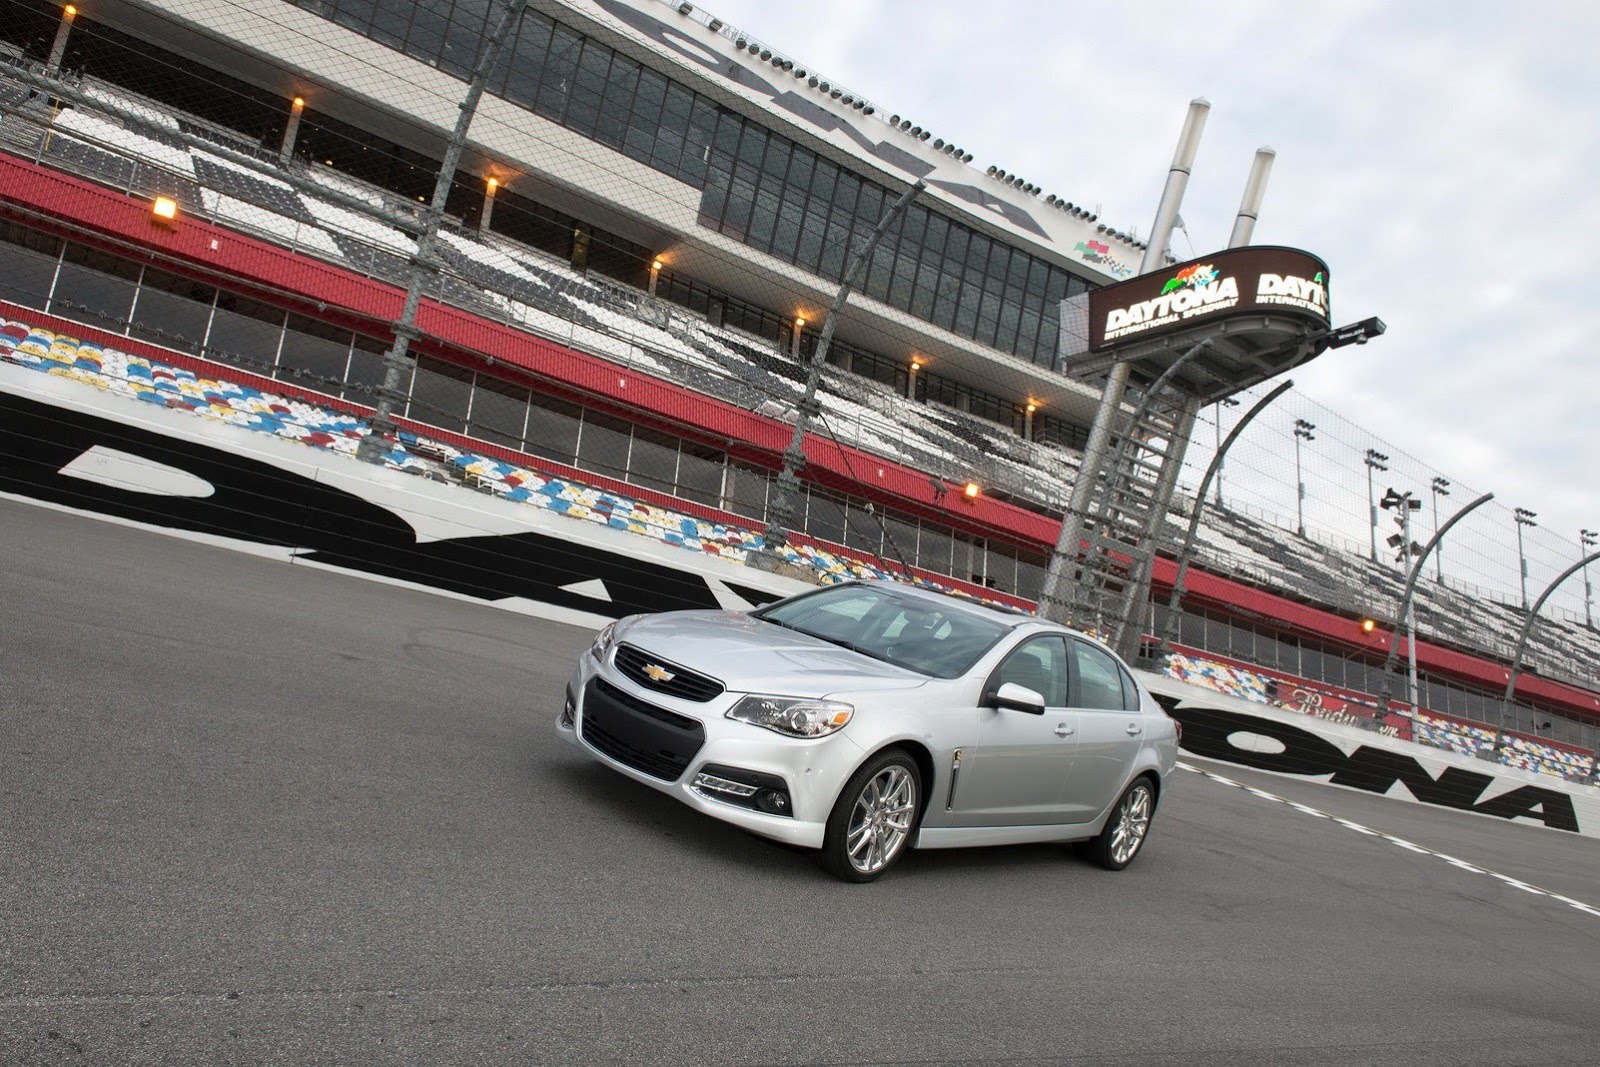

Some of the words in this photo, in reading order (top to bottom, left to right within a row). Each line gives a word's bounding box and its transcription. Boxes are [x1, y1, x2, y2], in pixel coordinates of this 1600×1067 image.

[1104, 313, 1180, 340] INTERNATIONAL
[1183, 298, 1239, 319] SPEEDWAY
[1105, 277, 1239, 332] DAYTONA
